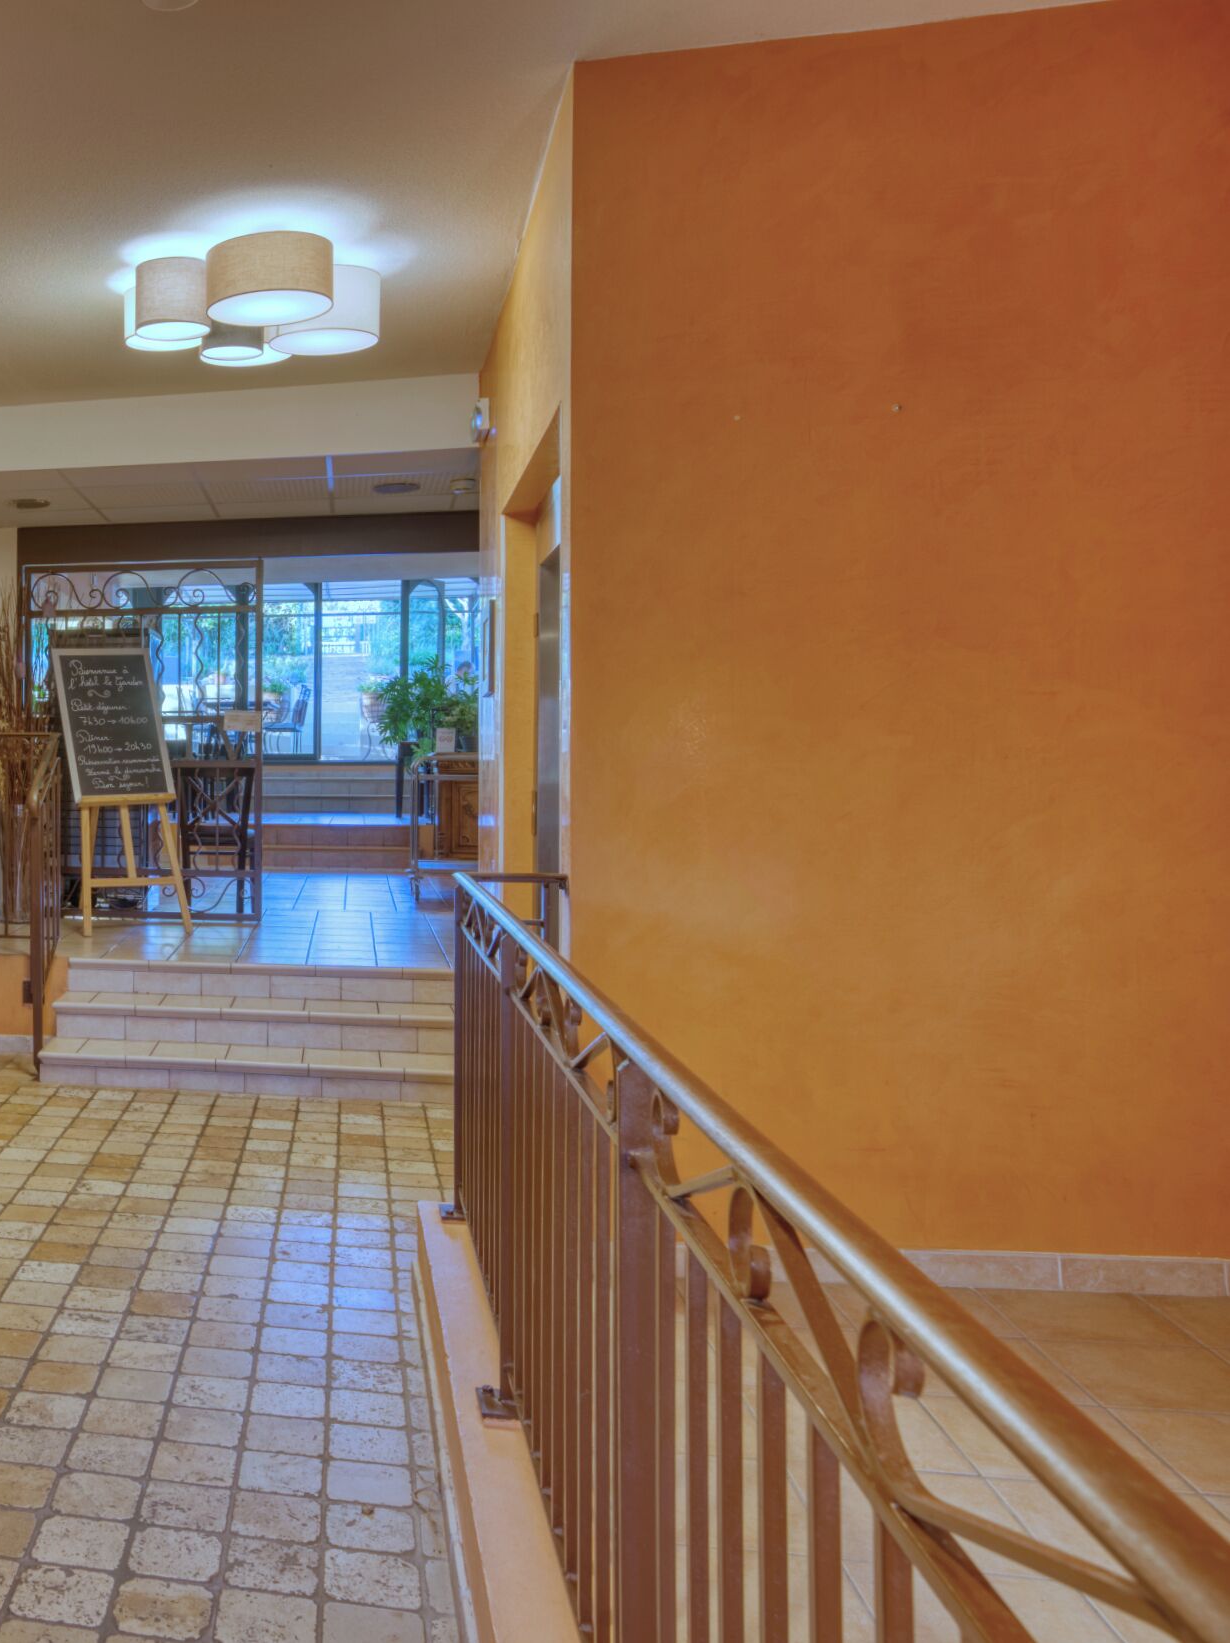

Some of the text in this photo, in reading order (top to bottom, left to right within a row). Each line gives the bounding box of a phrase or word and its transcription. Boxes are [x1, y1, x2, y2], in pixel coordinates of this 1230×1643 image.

[69, 659, 117, 676] Bienvenue
[118, 716, 148, 725] 10h00
[124, 741, 152, 752] 20h30
